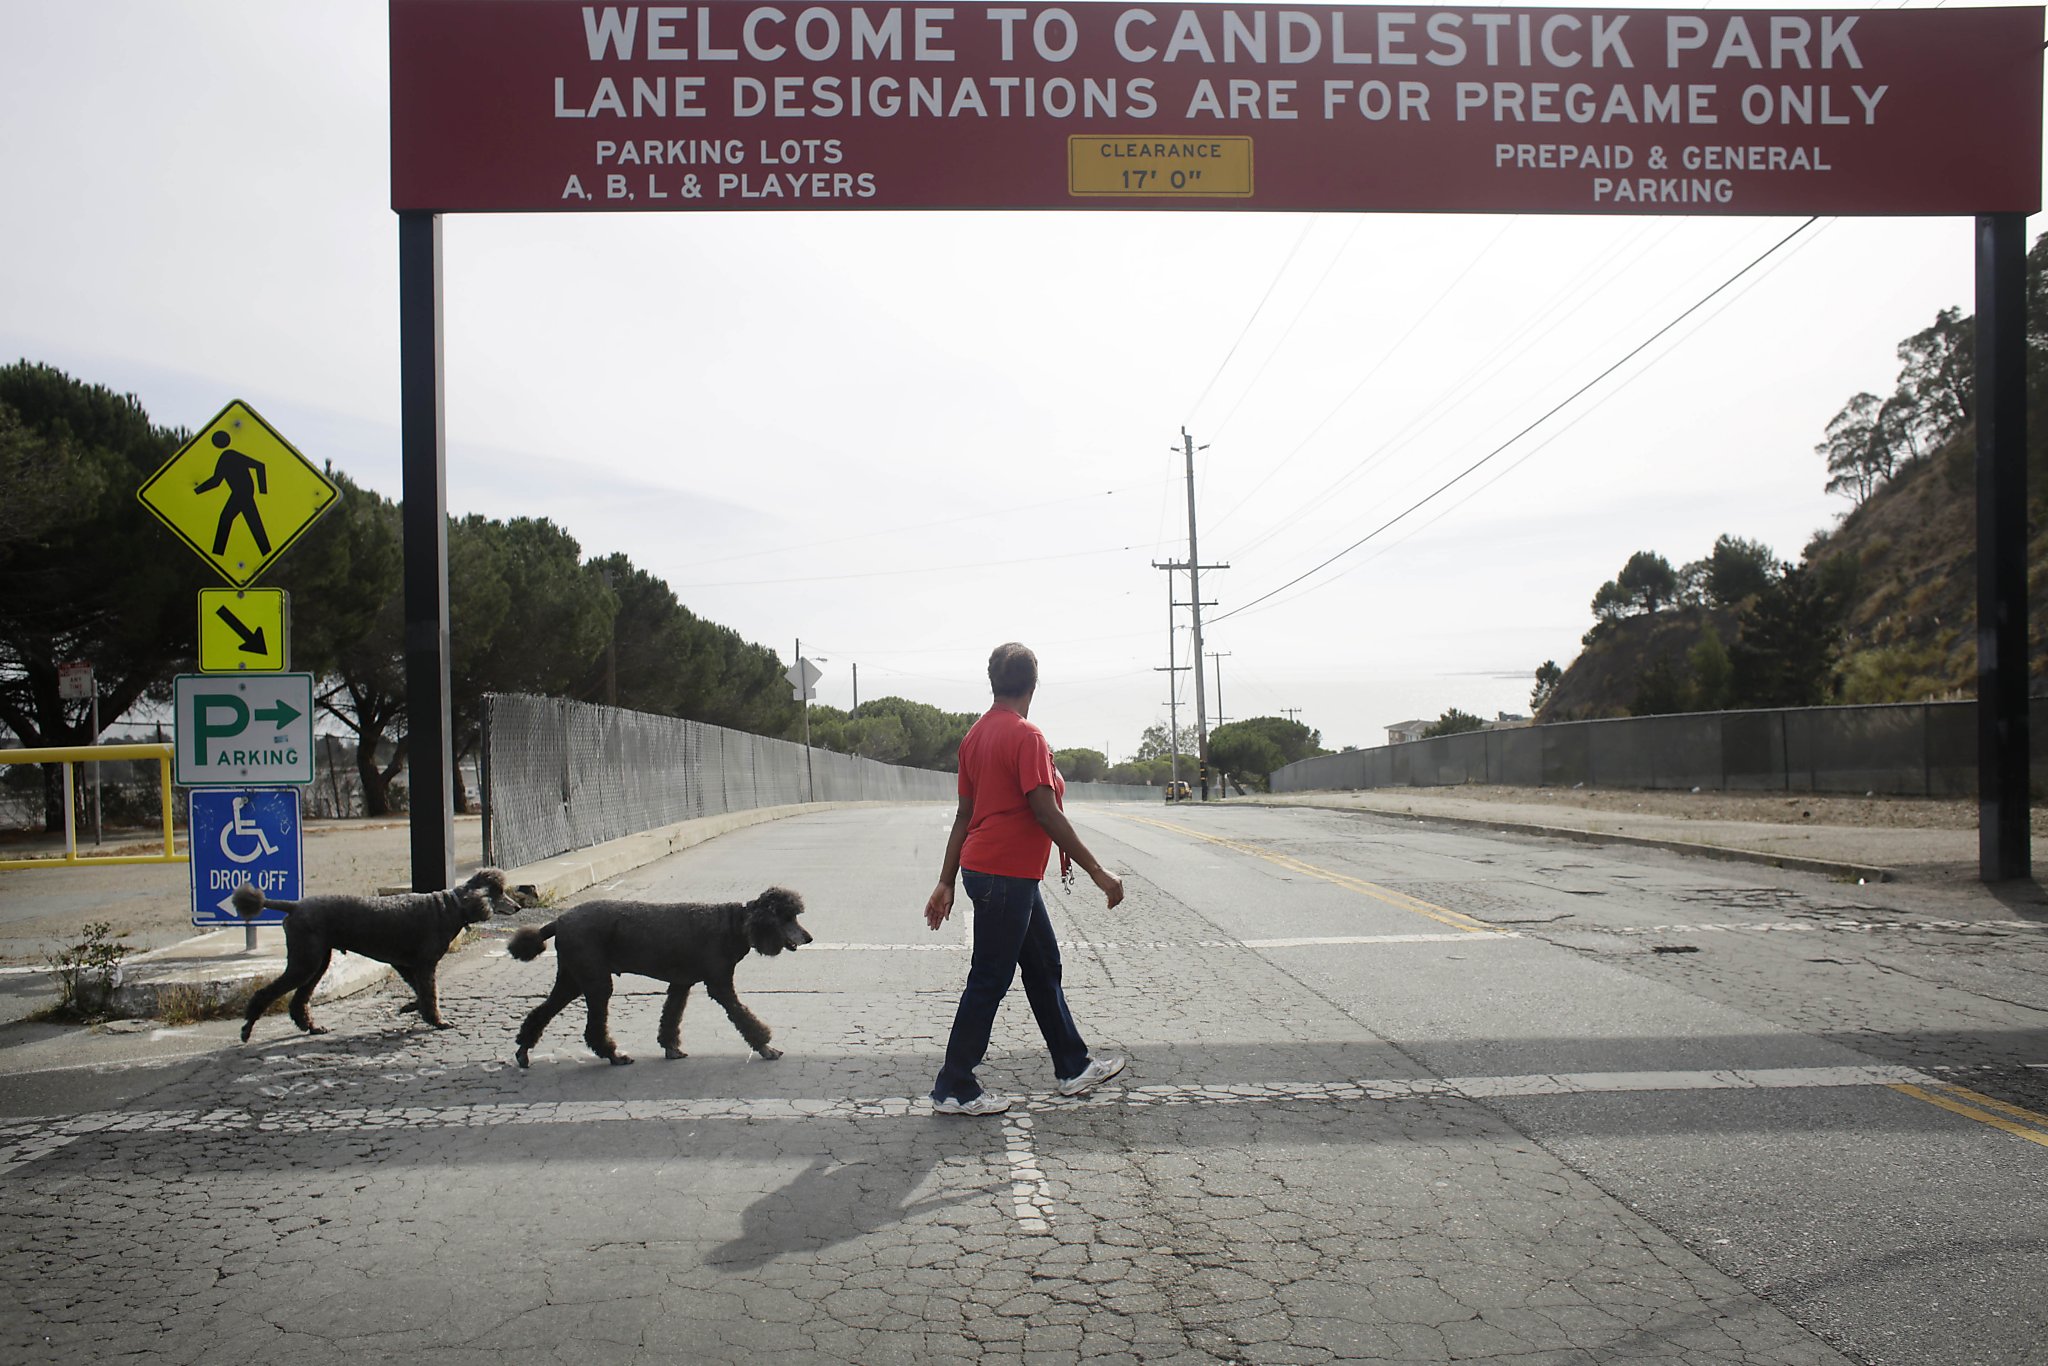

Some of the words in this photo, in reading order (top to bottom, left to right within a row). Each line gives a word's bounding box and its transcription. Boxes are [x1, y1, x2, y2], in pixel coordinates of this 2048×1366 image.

[581, 6, 956, 63] WELCOME
[986, 7, 1079, 63] TO
[1113, 8, 1635, 68] CANDLESTICK
[1666, 15, 1863, 69] PARK
[554, 76, 706, 118] LANE
[733, 76, 1158, 119] DESIGNATIONS
[1185, 78, 1299, 120] ARE
[1323, 79, 1431, 122] FOR
[1455, 81, 1718, 124] PREGAME
[1741, 84, 1889, 126] ONLY
[596, 139, 745, 165] PARKING
[760, 138, 844, 164] LOTS
[1100, 143, 1222, 159] CLEARANCE
[1495, 143, 1634, 170] PREPAID
[1648, 146, 1668, 170] &
[1682, 145, 1831, 171] GENERAL
[561, 174, 593, 201] A,
[607, 174, 635, 201] B,
[649, 174, 668, 198] L
[681, 173, 703, 199] &
[718, 172, 877, 198] PLAYERS
[1593, 177, 1733, 203] PARKING
[210, 869, 252, 890] DROP
[258, 869, 289, 890] OFF
